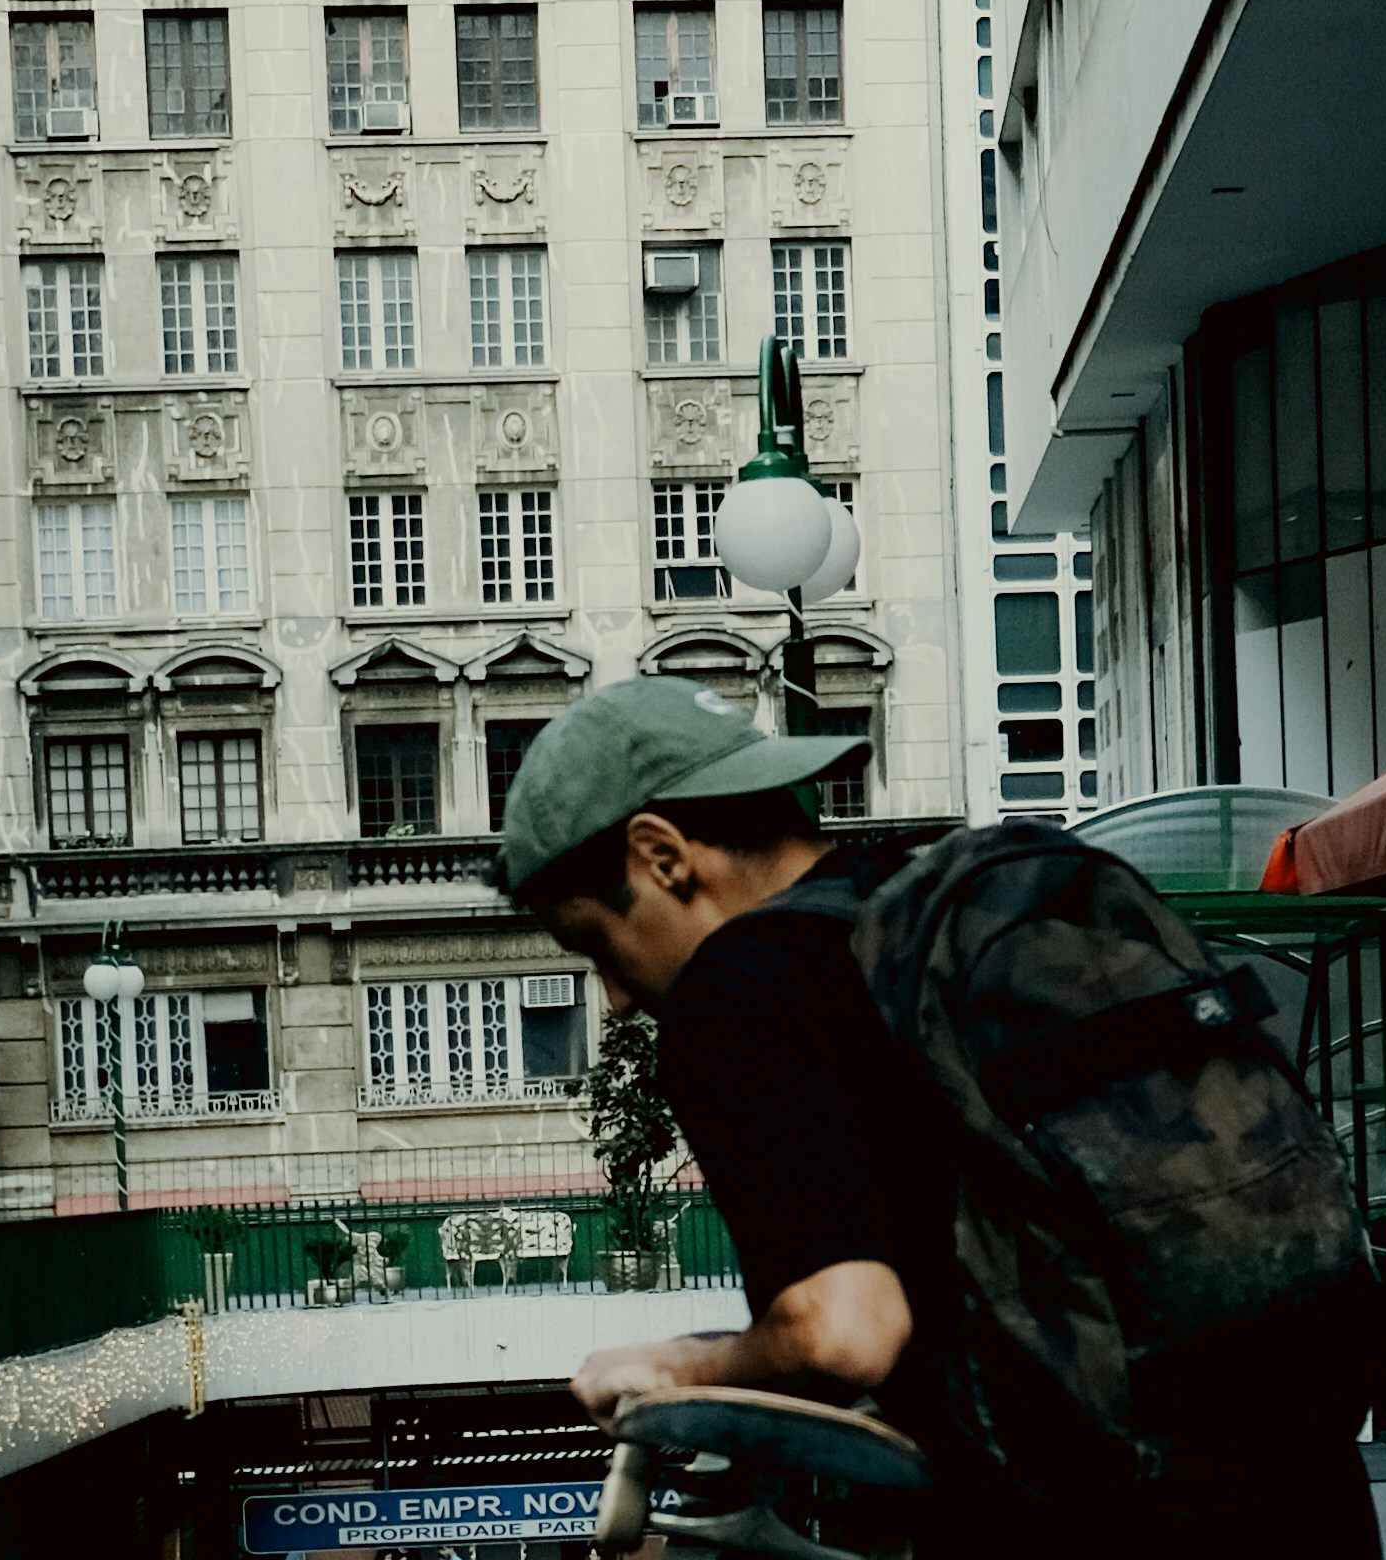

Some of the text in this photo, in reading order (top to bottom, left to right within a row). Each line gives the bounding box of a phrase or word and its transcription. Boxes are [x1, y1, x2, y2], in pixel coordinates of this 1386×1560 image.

[274, 1500, 388, 1526] COND.
[399, 1493, 512, 1521] EMPR.
[523, 1491, 601, 1516] NOV
[346, 1519, 597, 1542] PROPRIEDADE PART
